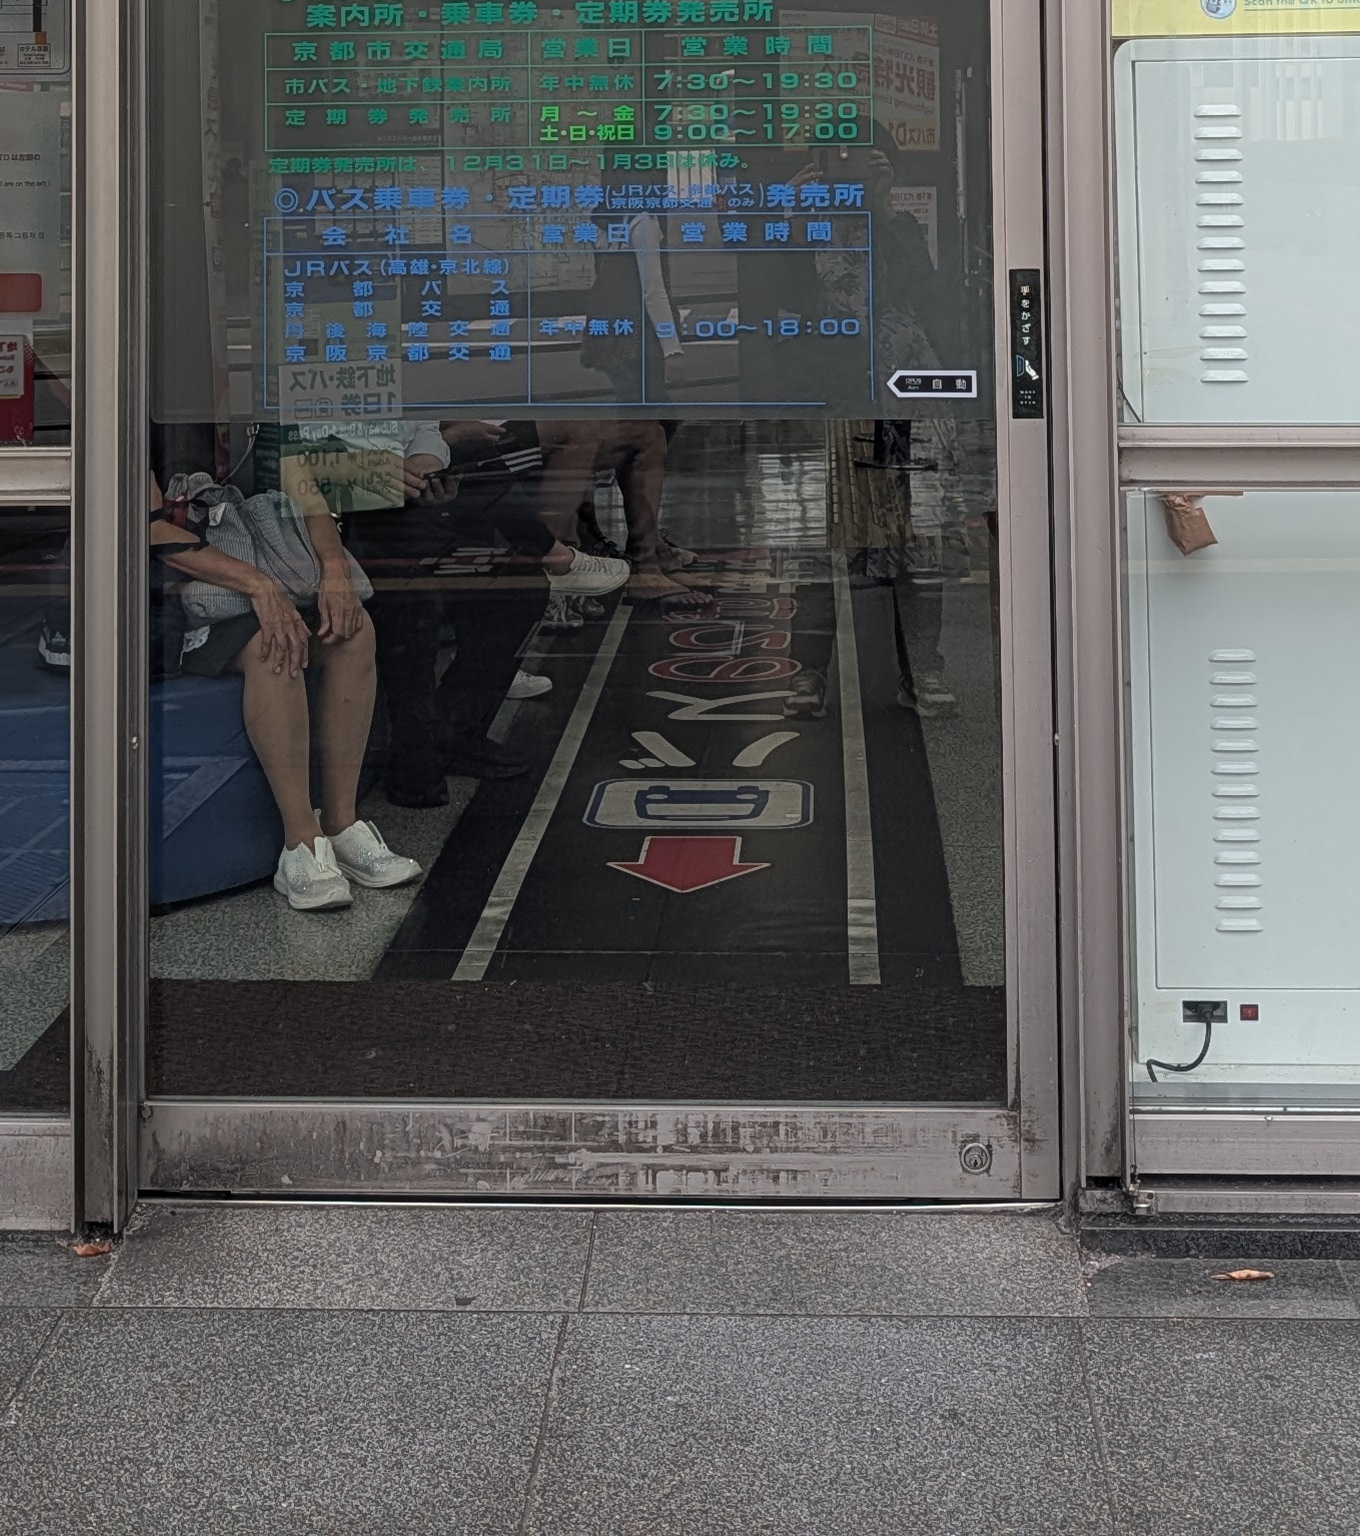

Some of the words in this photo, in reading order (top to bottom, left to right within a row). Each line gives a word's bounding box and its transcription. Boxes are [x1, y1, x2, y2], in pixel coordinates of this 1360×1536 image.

[292, 38, 505, 61] 京都市交通局
[541, 37, 632, 60] 営業日
[681, 34, 833, 58] 営業時間
[284, 75, 512, 96] 市バス・地下鉄案内所
[540, 72, 635, 93] 年中無休
[284, 106, 512, 126] 定期券発売所
[540, 123, 636, 143] 土・日・祝日
[305, 184, 604, 211] バス乗車券・定期券
[766, 184, 865, 209] 発売所
[610, 196, 713, 210] 京阪京都交通
[727, 197, 756, 208] のみ
[322, 224, 473, 247] 会社名
[541, 222, 631, 244] 営業日
[681, 221, 833, 244] 営業時間
[283, 279, 511, 298] 京都バス
[283, 299, 511, 318] 京都交通
[540, 318, 635, 338] 年中無休
[283, 343, 512, 362] 京阪京都交通
